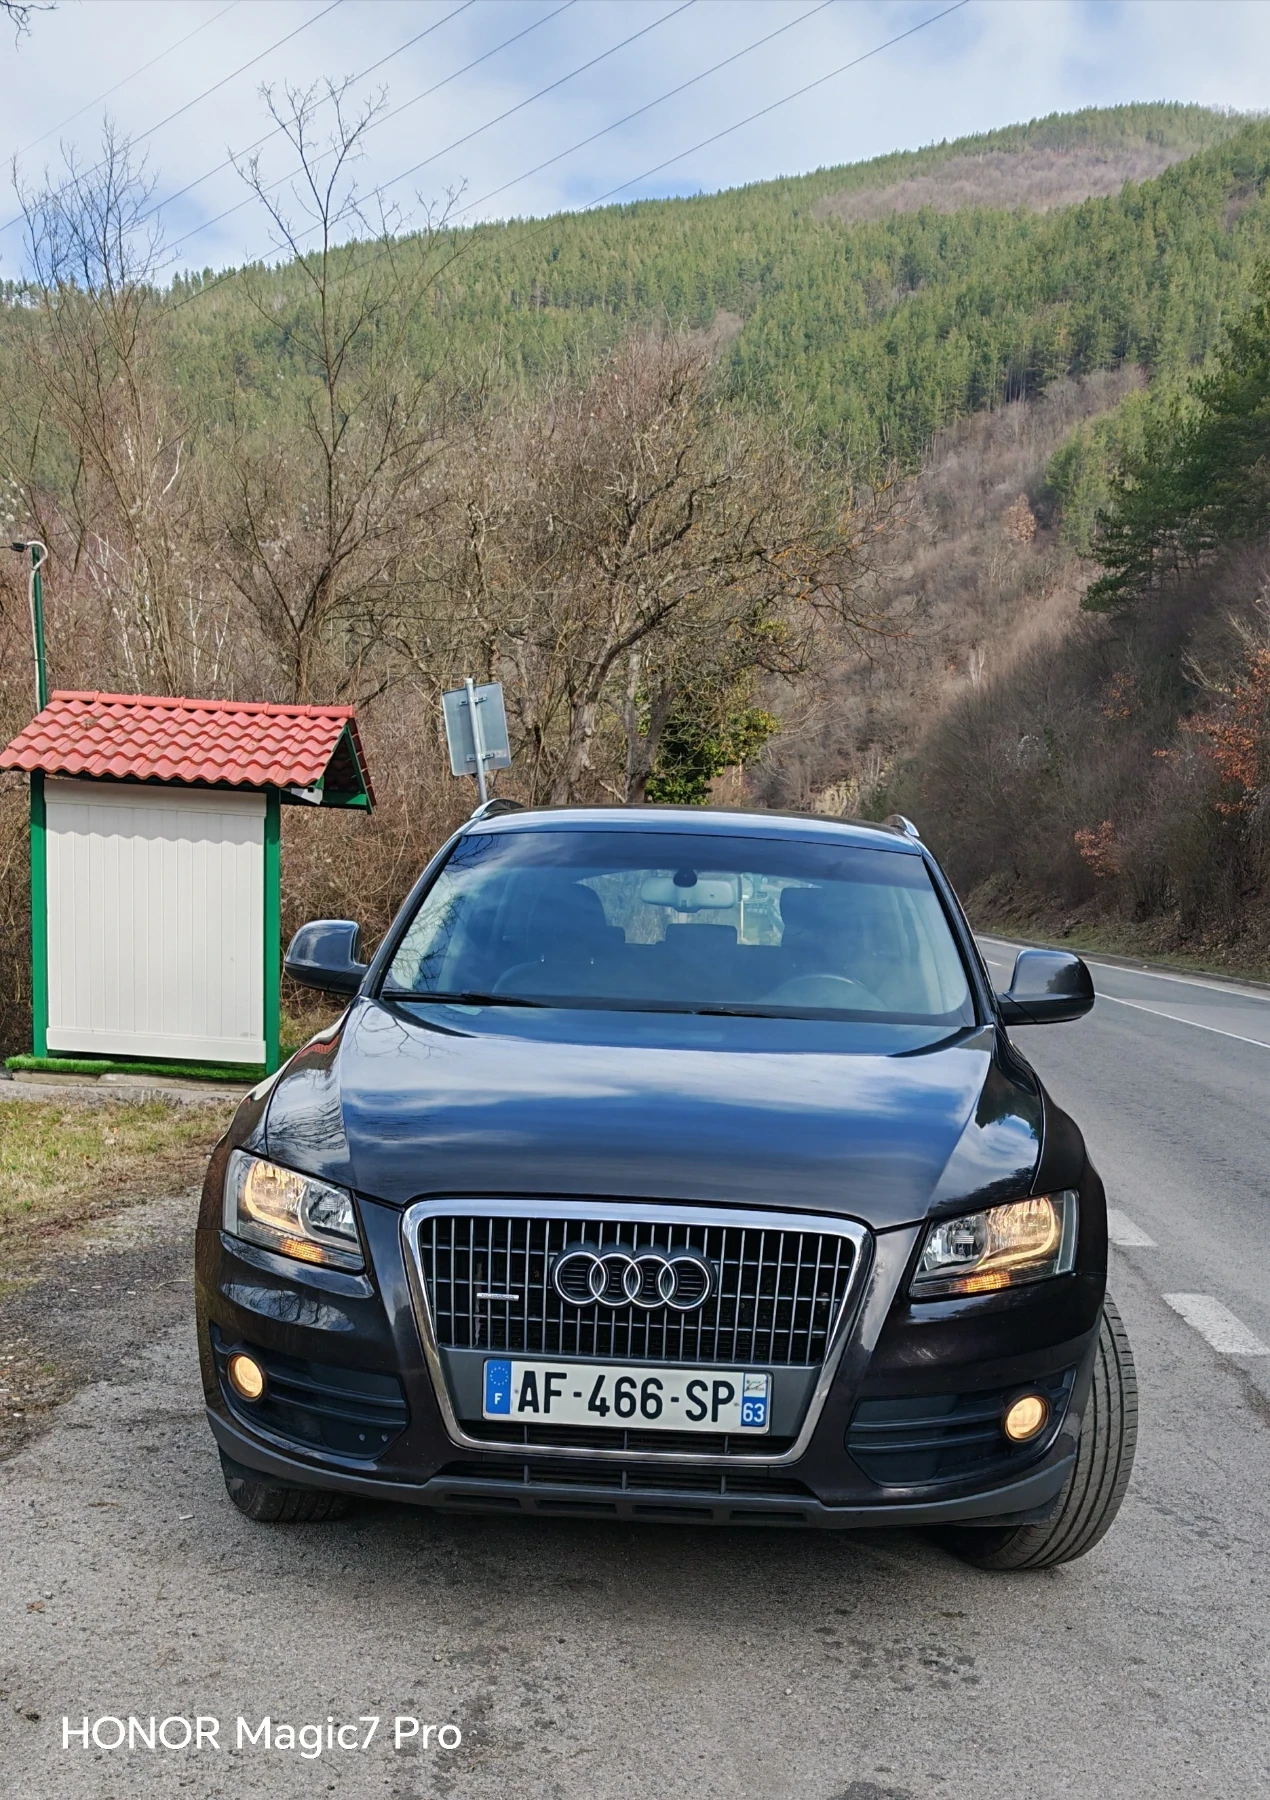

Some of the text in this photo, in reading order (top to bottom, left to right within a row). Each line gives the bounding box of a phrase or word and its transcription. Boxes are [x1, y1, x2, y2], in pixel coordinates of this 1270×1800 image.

[494, 1393, 503, 1405] F
[517, 1370, 735, 1423] AF-466-SP
[743, 1402, 765, 1423] 63
